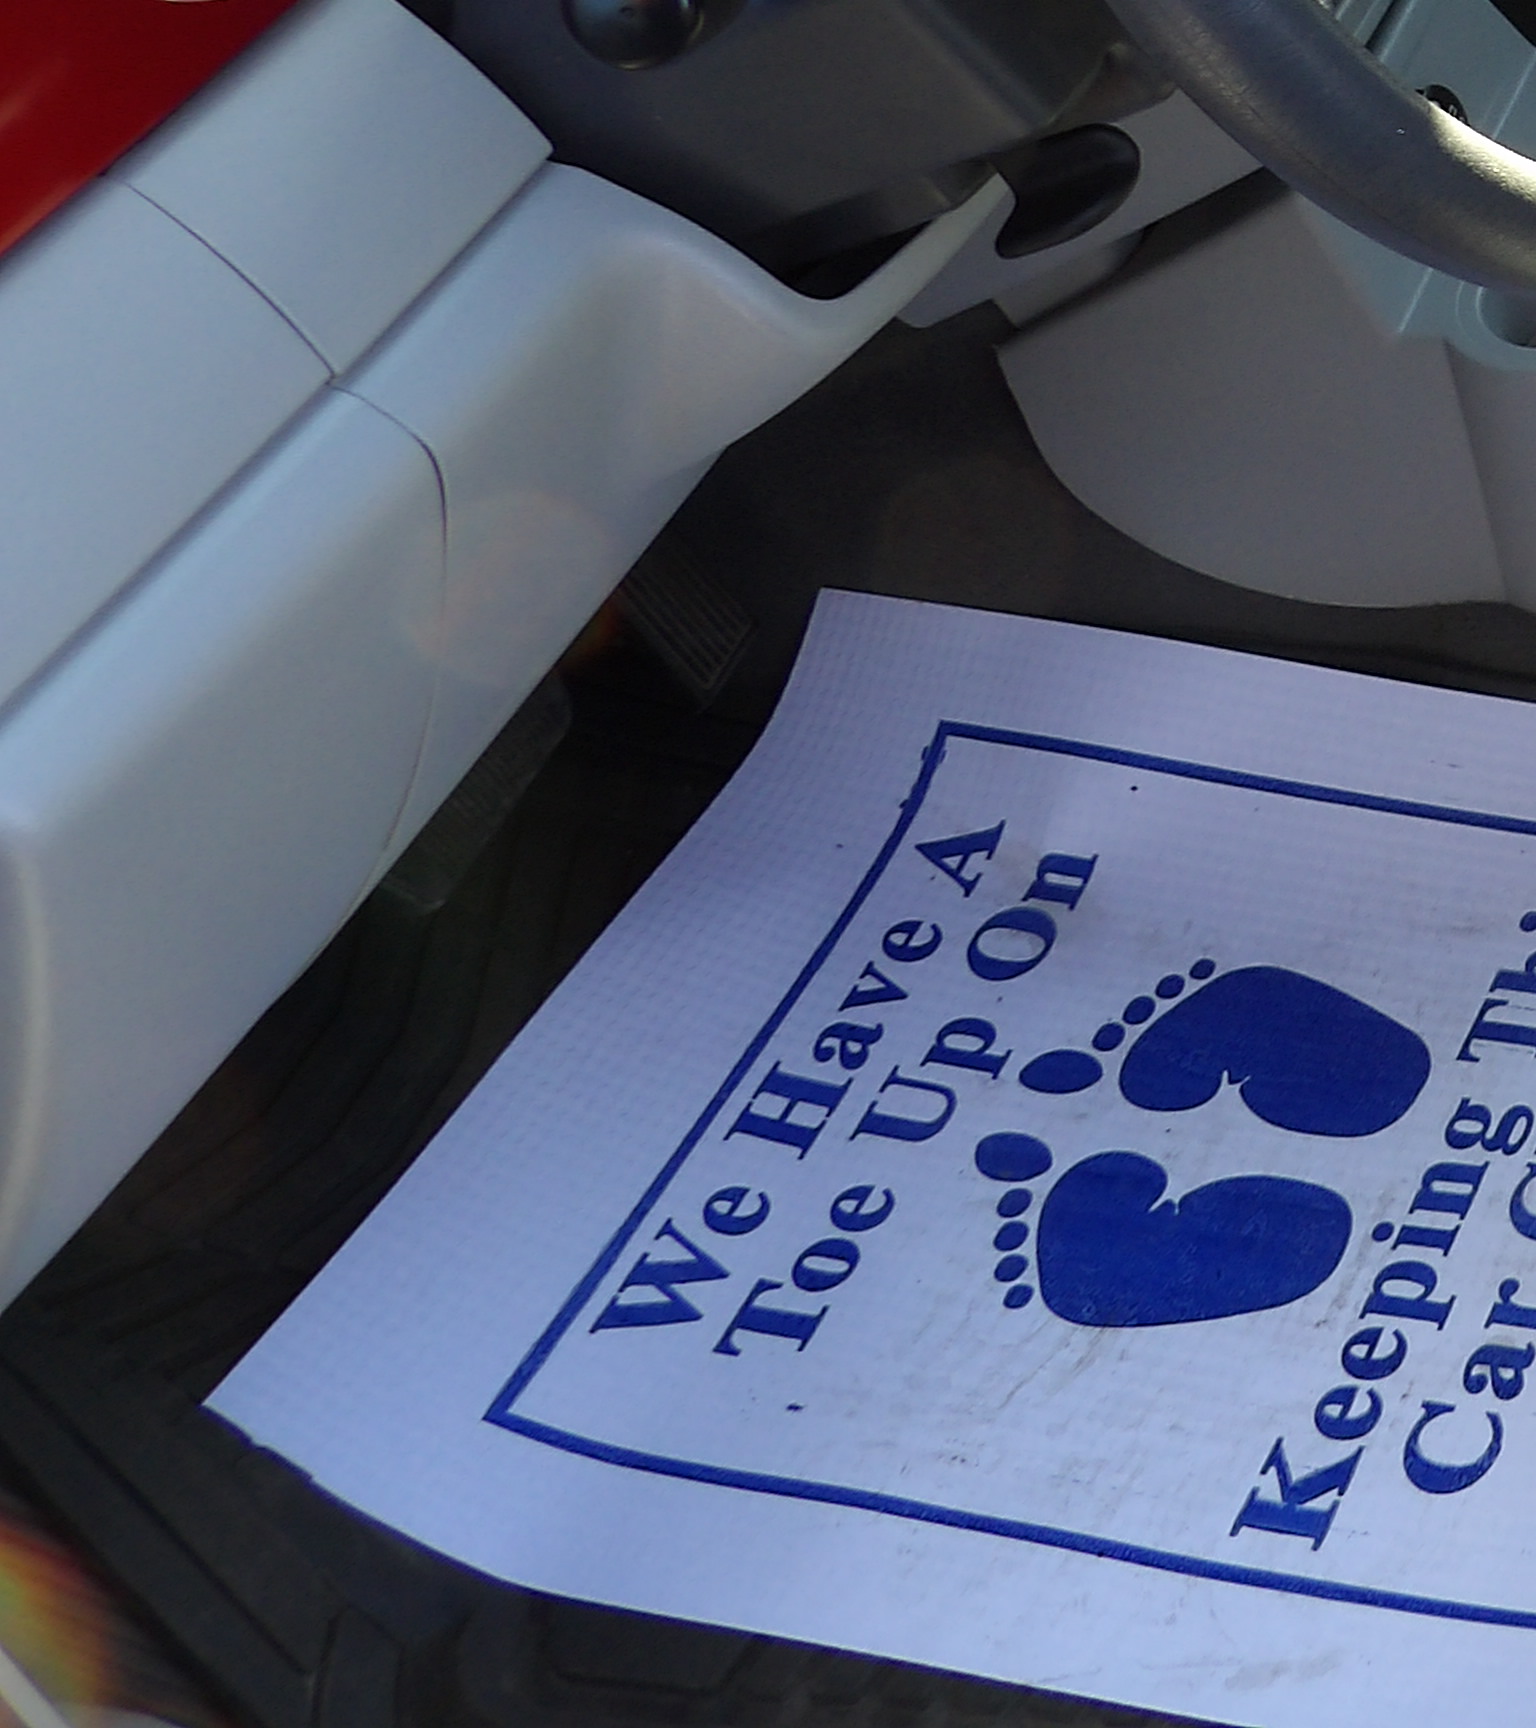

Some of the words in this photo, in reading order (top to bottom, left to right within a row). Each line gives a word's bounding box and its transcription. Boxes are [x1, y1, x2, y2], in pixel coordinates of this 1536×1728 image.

[588, 1186, 772, 1335] We
[723, 919, 945, 1161] Have
[913, 819, 1007, 899] A
[712, 1185, 896, 1358] Toe
[847, 1016, 1014, 1143] Up
[965, 852, 1100, 983] On
[1229, 1097, 1535, 1552] Keeping
